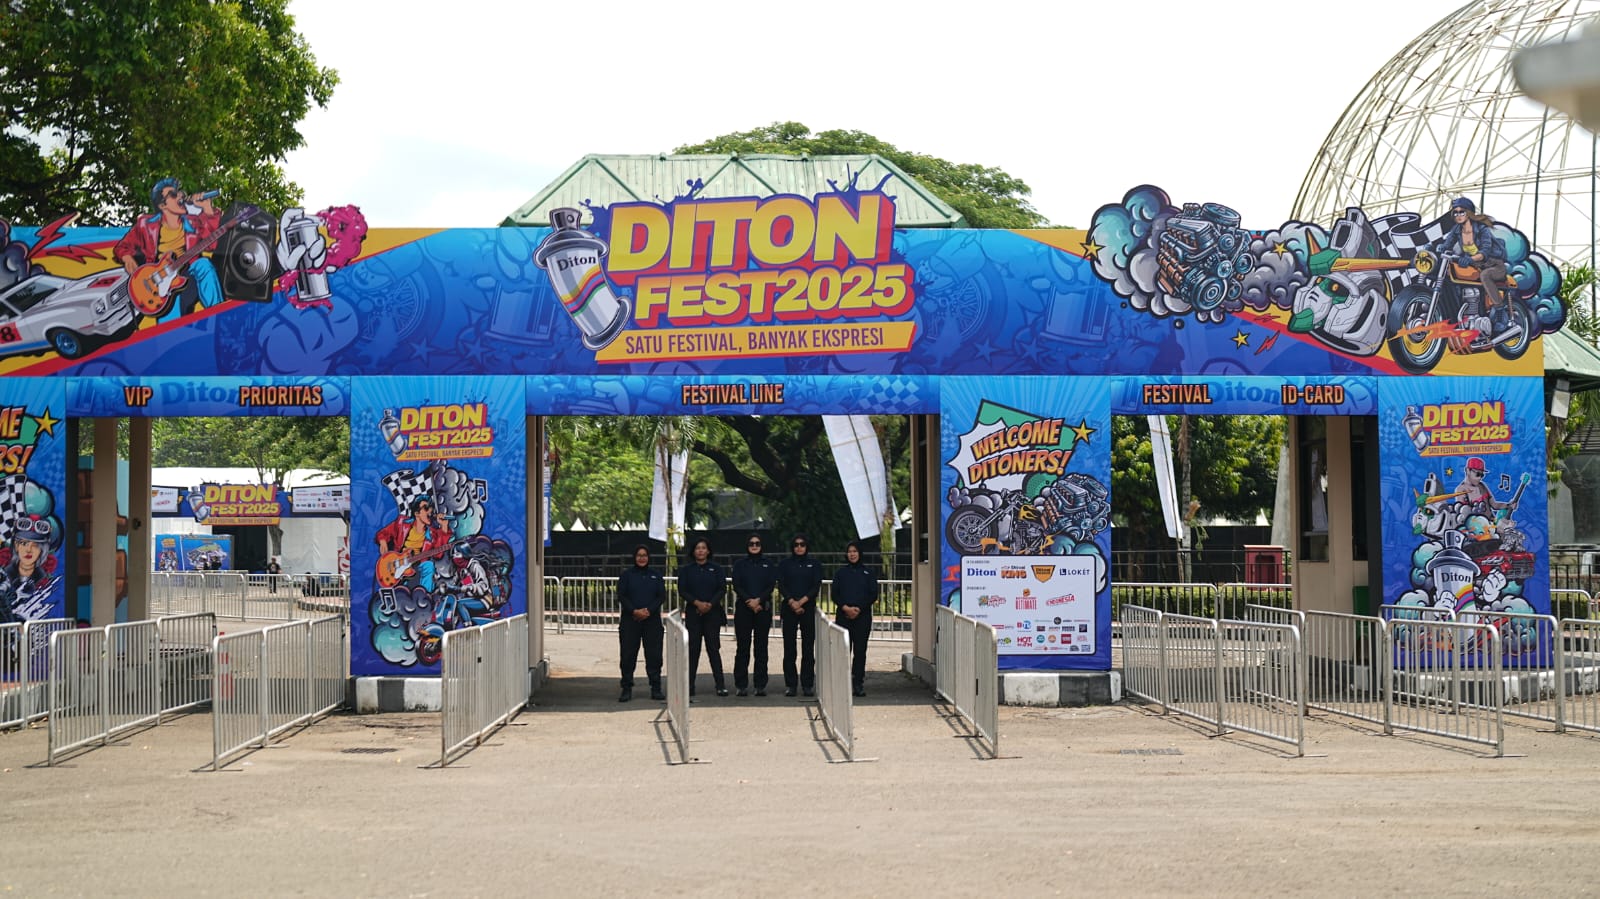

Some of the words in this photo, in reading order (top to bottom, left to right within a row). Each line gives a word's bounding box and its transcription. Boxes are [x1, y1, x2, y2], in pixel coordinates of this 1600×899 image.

[606, 194, 880, 272] DITON
[557, 253, 597, 272] Diton
[633, 265, 907, 321] FEST2025
[625, 334, 662, 355] SATU
[668, 331, 742, 354] FESTIVAL,
[748, 328, 808, 350] BANYAK
[813, 326, 884, 348] EKSPRESI
[124, 386, 152, 407] VIP
[240, 386, 323, 406] PRIORITAS
[682, 384, 748, 405] FESTIVAL
[751, 384, 784, 403] LINE
[1143, 384, 1212, 405] FESTIVAL
[1282, 384, 1345, 405] ID-CARD
[400, 404, 484, 431] DITON
[1423, 401, 1501, 427] DITON
[971, 418, 1065, 461] WELCOME
[968, 450, 1073, 485] DITONERS!
[205, 485, 273, 503] DITON
[967, 568, 996, 577] Diton
[1441, 572, 1471, 583] Diton
